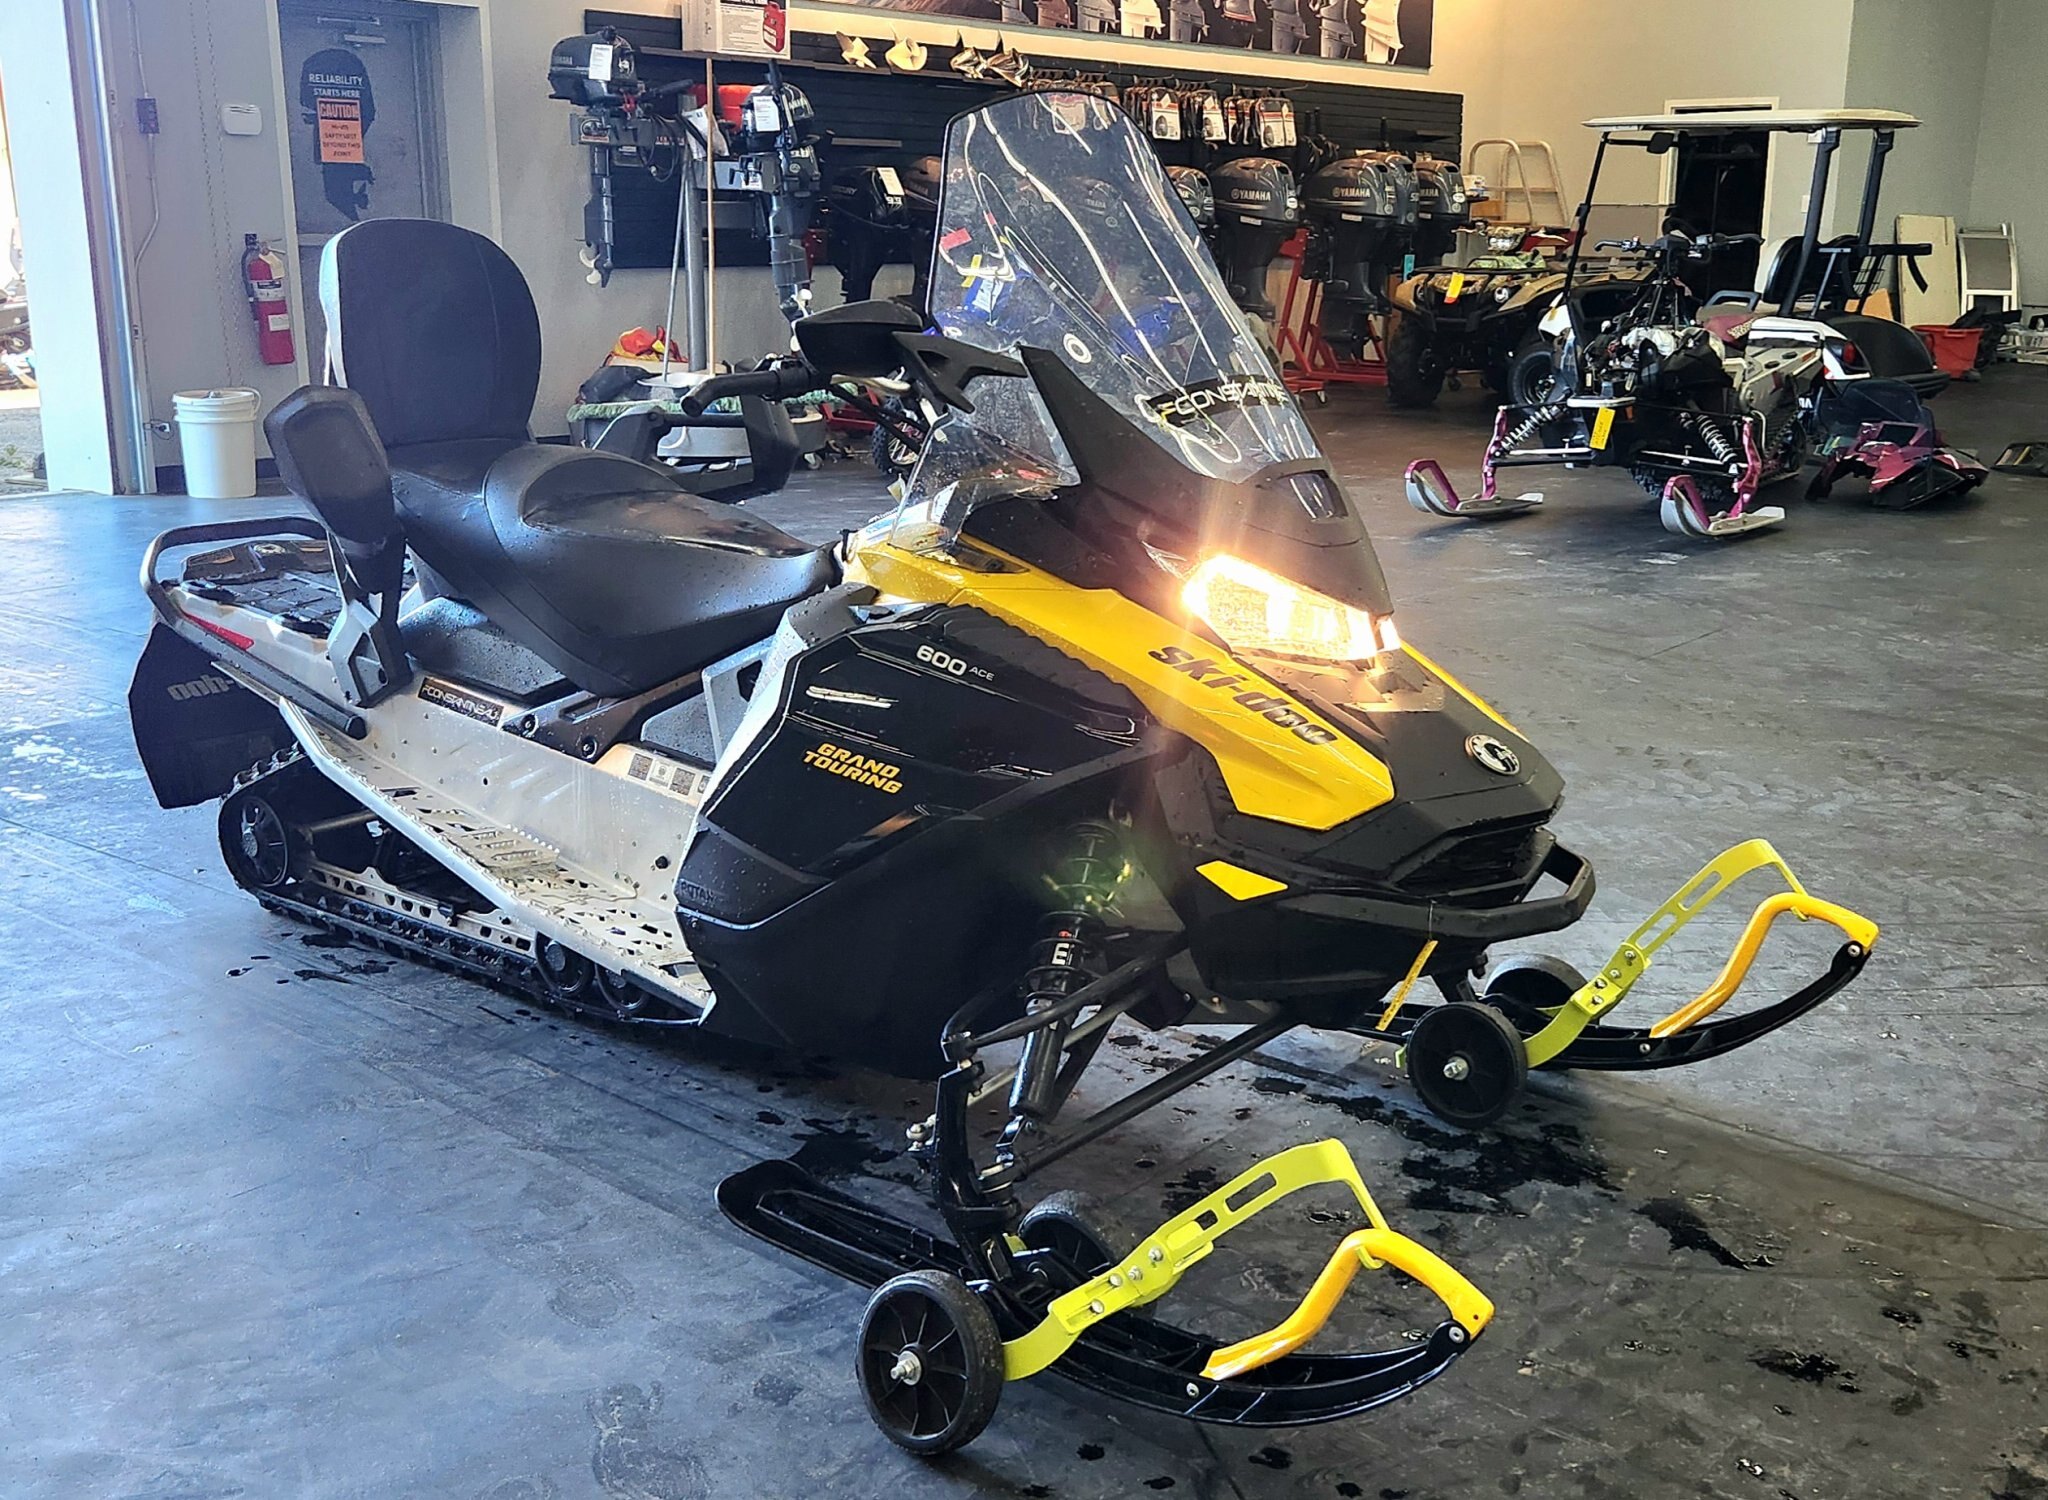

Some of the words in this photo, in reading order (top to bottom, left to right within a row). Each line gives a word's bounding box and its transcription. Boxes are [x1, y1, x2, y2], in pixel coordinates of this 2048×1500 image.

[308, 73, 363, 86] RELIABILITY
[313, 88, 340, 96] STARTS
[341, 89, 361, 98] HERE
[1239, 190, 1272, 202] YAMAHA
[1339, 187, 1371, 198] YAMAHA
[916, 644, 967, 676] 600
[968, 666, 995, 682] ACE
[817, 742, 901, 780] GRAND
[803, 750, 903, 794] TOURING
